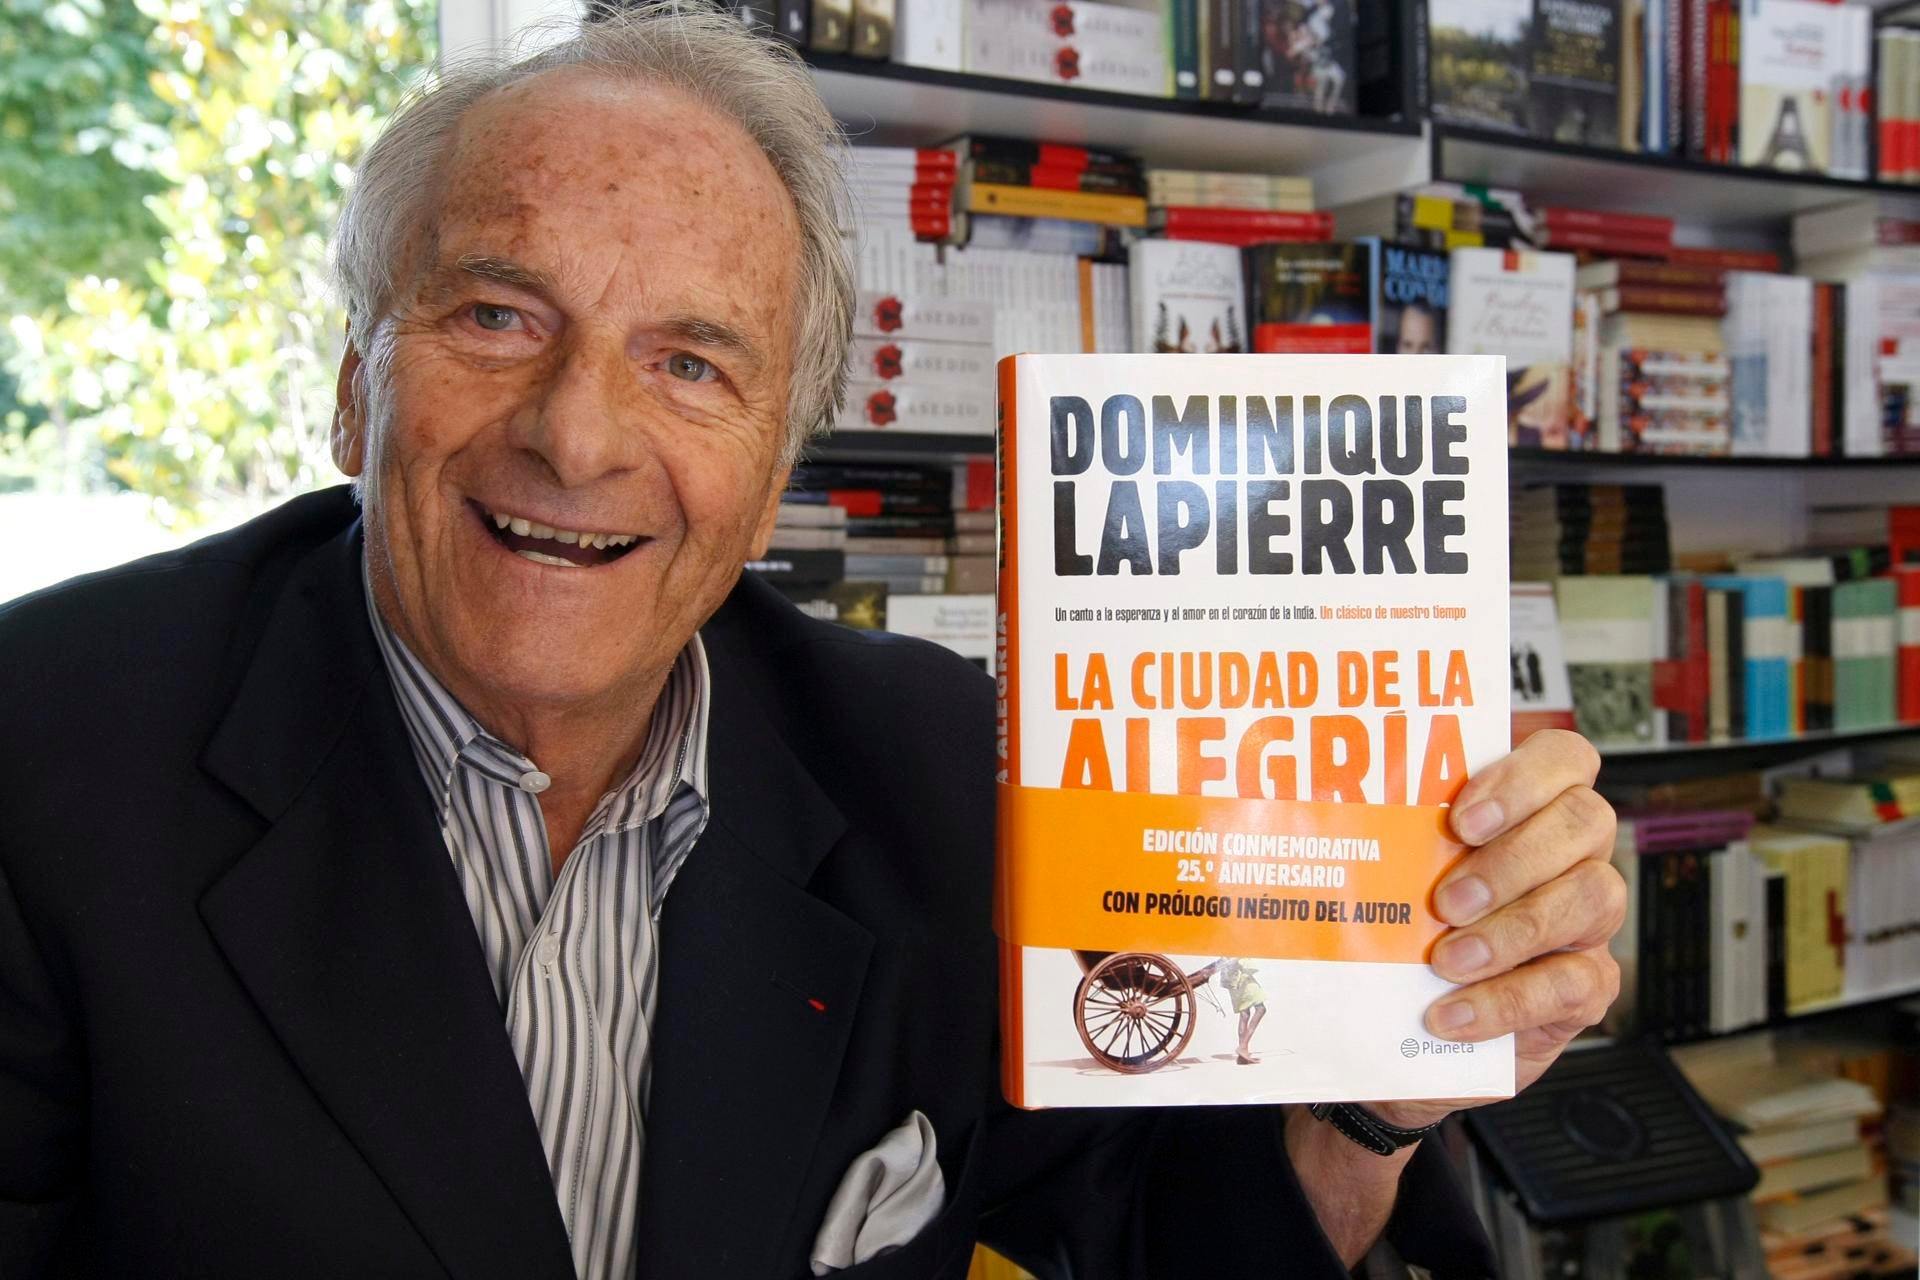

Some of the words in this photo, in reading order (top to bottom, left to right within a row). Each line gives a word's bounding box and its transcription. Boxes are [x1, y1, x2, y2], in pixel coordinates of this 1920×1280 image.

[1050, 394, 1470, 476] DOMINIQUE
[1053, 479, 1469, 577] LAPIERRE
[1055, 607, 1067, 621] Un
[1069, 608, 1093, 621] canto
[1096, 610, 1102, 621] a
[1104, 607, 1113, 621] la
[1115, 609, 1161, 623] esperanza
[1163, 609, 1169, 623] y
[1172, 606, 1180, 620] al
[1182, 608, 1206, 620] amor
[1208, 608, 1219, 620] en
[1222, 606, 1230, 620] el
[1232, 605, 1267, 620] corazón
[1269, 606, 1280, 620] de
[1283, 606, 1291, 620] la
[1293, 606, 1317, 620] India.
[1320, 606, 1333, 620] Un
[1336, 605, 1372, 620] clásico
[1375, 606, 1387, 620] de
[1390, 606, 1430, 620] nuestro
[1433, 606, 1466, 621] tiempo
[1055, 652, 1114, 711] LA
[1131, 651, 1320, 710] CIUDAD
[1337, 650, 1401, 708] DE
[1418, 649, 1474, 707] LA
[1060, 711, 1470, 806] ALEGRÍA
[1143, 827, 1218, 856] EDICIÓN
[1222, 832, 1381, 862] CONMEMORATIVA
[1218, 861, 1345, 888] ANIVERSARIO
[1102, 890, 1140, 914] CON
[1145, 889, 1231, 918] PRÓLOGO
[1236, 893, 1310, 921] INÉDITO
[1315, 900, 1348, 923] DEL
[1353, 902, 1411, 925] AUTOR
[1422, 1040, 1475, 1055] Planeta
